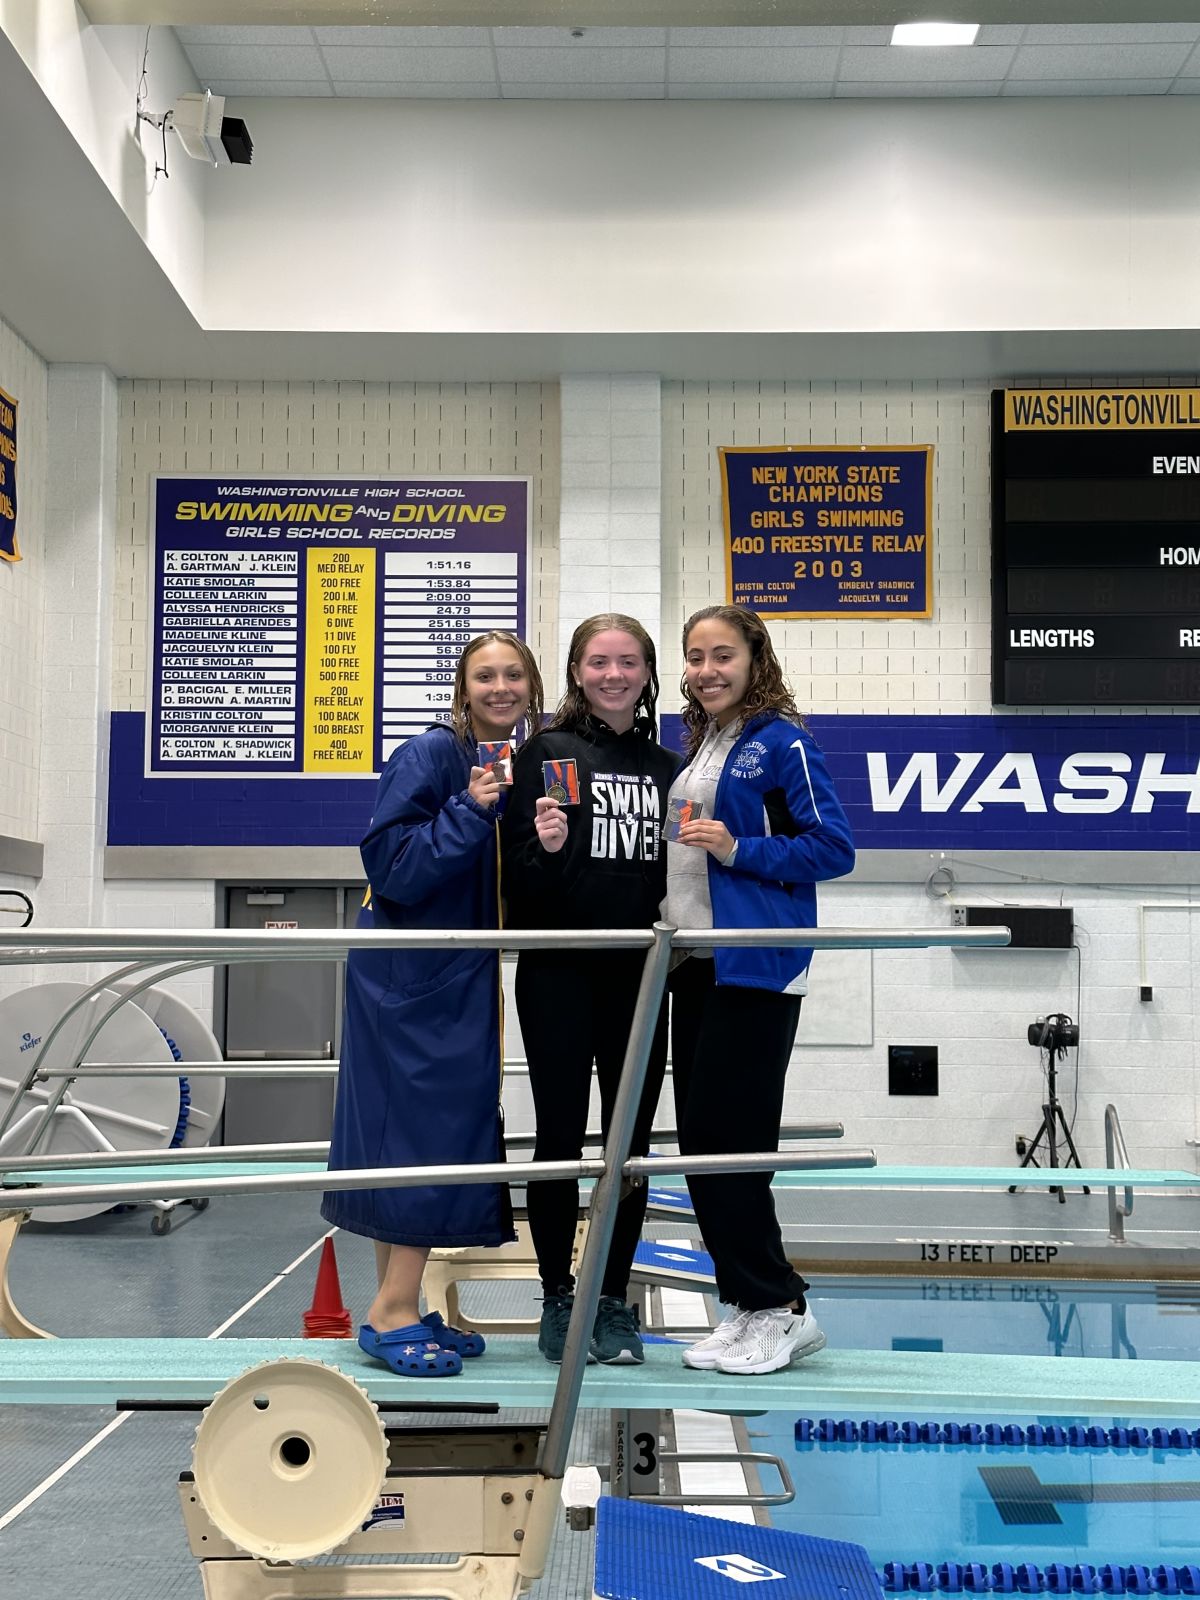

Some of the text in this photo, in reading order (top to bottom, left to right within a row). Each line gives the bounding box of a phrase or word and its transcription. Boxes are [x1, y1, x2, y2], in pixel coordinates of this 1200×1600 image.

[1013, 395, 1200, 425] WASHINGTONVILL
[1153, 457, 1200, 474] EVEN
[752, 466, 900, 484] NEW YORK STATE
[217, 487, 466, 498] WASHINGTONVILLE HIGH SCHOOL
[769, 485, 883, 502] CHAMPIONS
[175, 502, 506, 523] SWIMMING AND DIVING
[751, 509, 904, 528] GIRLS SWIMMING
[226, 527, 456, 539] GIRLS SCHOOL RECORDS
[732, 535, 925, 553] 400 FREESTYLE RELAY
[251, 554, 296, 562] LARKIN
[332, 553, 350, 562] 200
[167, 563, 296, 572] A. GARTMAN J. KLEIN
[317, 564, 364, 573] MED RELAY
[426, 561, 471, 569] 1:51.16
[795, 560, 862, 578] 2003
[167, 578, 255, 586] KATIE SMOLAR
[321, 578, 361, 588] 200 FREE
[426, 580, 471, 588] 1:53.84
[735, 582, 796, 591] KRISTIN COLTON
[166, 591, 267, 600] COLLEEN LARKIN
[323, 592, 358, 601] 200 I.M.
[426, 593, 471, 601] 2:09.00
[166, 605, 285, 613] ALYSSA HENDRICKS
[323, 605, 358, 614] 50 FREE
[437, 607, 471, 615] 24.79
[166, 618, 291, 626] GABRIELLA ARENDES
[327, 618, 354, 628] 6 DIVE
[428, 620, 471, 628] 251.65
[165, 631, 267, 640] MADELINE KLINE
[324, 631, 356, 641] 11 DIVE
[428, 633, 471, 641] 444.80
[1010, 630, 1095, 647] LENGTHS
[1180, 630, 1200, 647] RE
[164, 645, 274, 653] JACQUELYN KLEIN
[324, 645, 356, 654] 100 FLY
[165, 658, 253, 666] KATIE SMOLAR
[320, 658, 359, 668] 100 FREE
[164, 671, 265, 679] COLLEEN LARKIN
[319, 672, 359, 681] 500 FREE
[426, 673, 455, 681] 5:00.
[164, 686, 292, 694] P. BACIGAL E. MILLER
[331, 687, 348, 696] 200
[164, 697, 291, 705] O. BROWN A. MARTIN
[314, 697, 363, 707] FREE RELAY
[425, 693, 453, 702] 1:39.
[164, 711, 263, 720] KRISTIN COLTON
[318, 711, 360, 721] 100 BACK
[435, 713, 450, 721] 58
[163, 725, 273, 733] MORGANNE KLEIN
[313, 725, 364, 734] 100 BREAST
[162, 740, 292, 749] K. COLTON K. SHADWICK
[330, 740, 347, 749] 400
[162, 750, 292, 759] A. GARTMAN J. KLEIN
[313, 751, 362, 760] FREE RELAY
[867, 752, 1200, 813] WASH
[591, 781, 660, 819] SWIM
[625, 813, 635, 825] &
[590, 816, 653, 861] DIVE
[19, 1036, 42, 1053] Kiefer
[921, 1243, 1058, 1263] 13 FEET DEEP
[633, 1432, 657, 1475] 3
